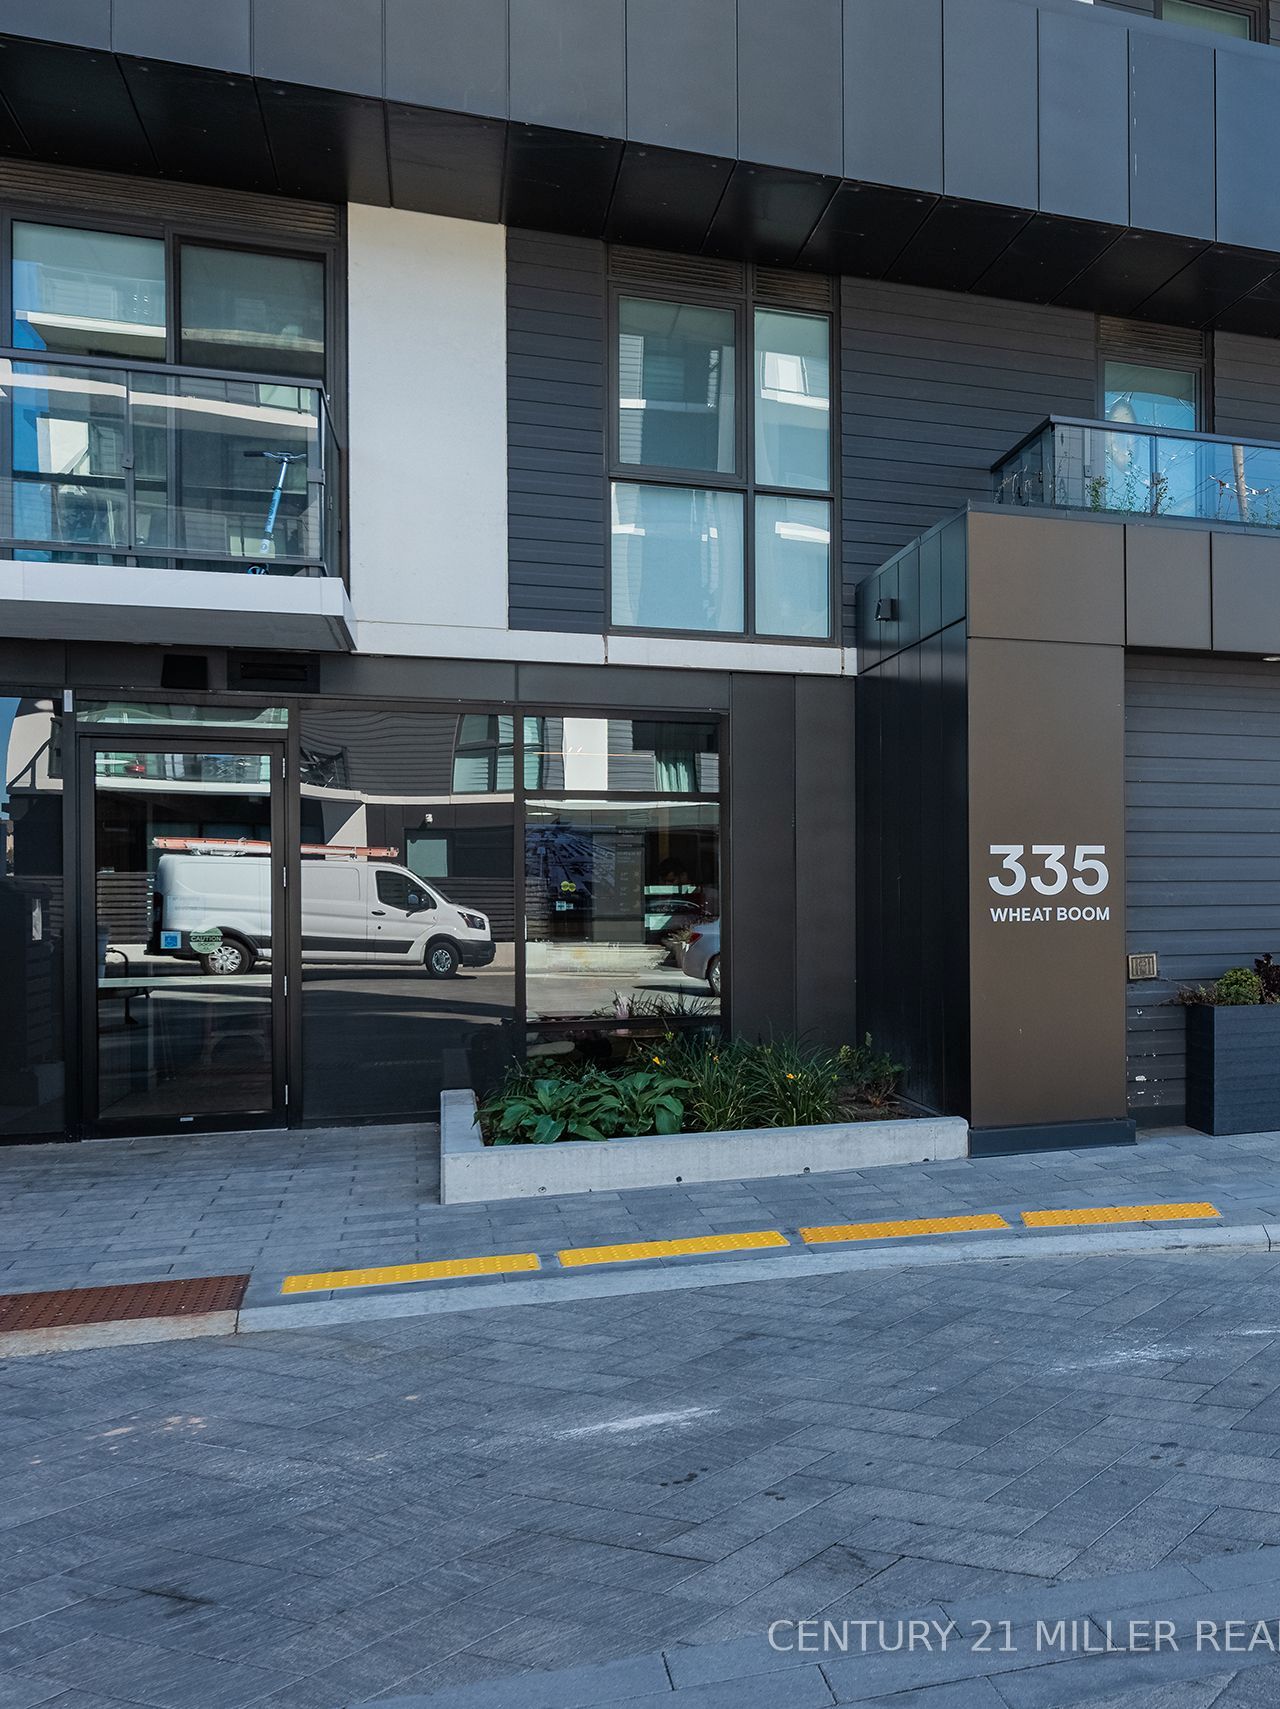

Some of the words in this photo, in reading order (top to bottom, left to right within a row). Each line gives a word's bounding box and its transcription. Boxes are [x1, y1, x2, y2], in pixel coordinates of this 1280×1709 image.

[988, 844, 1109, 896] 335
[990, 907, 1052, 922] WHEAT
[1056, 906, 1110, 921] BOOM
